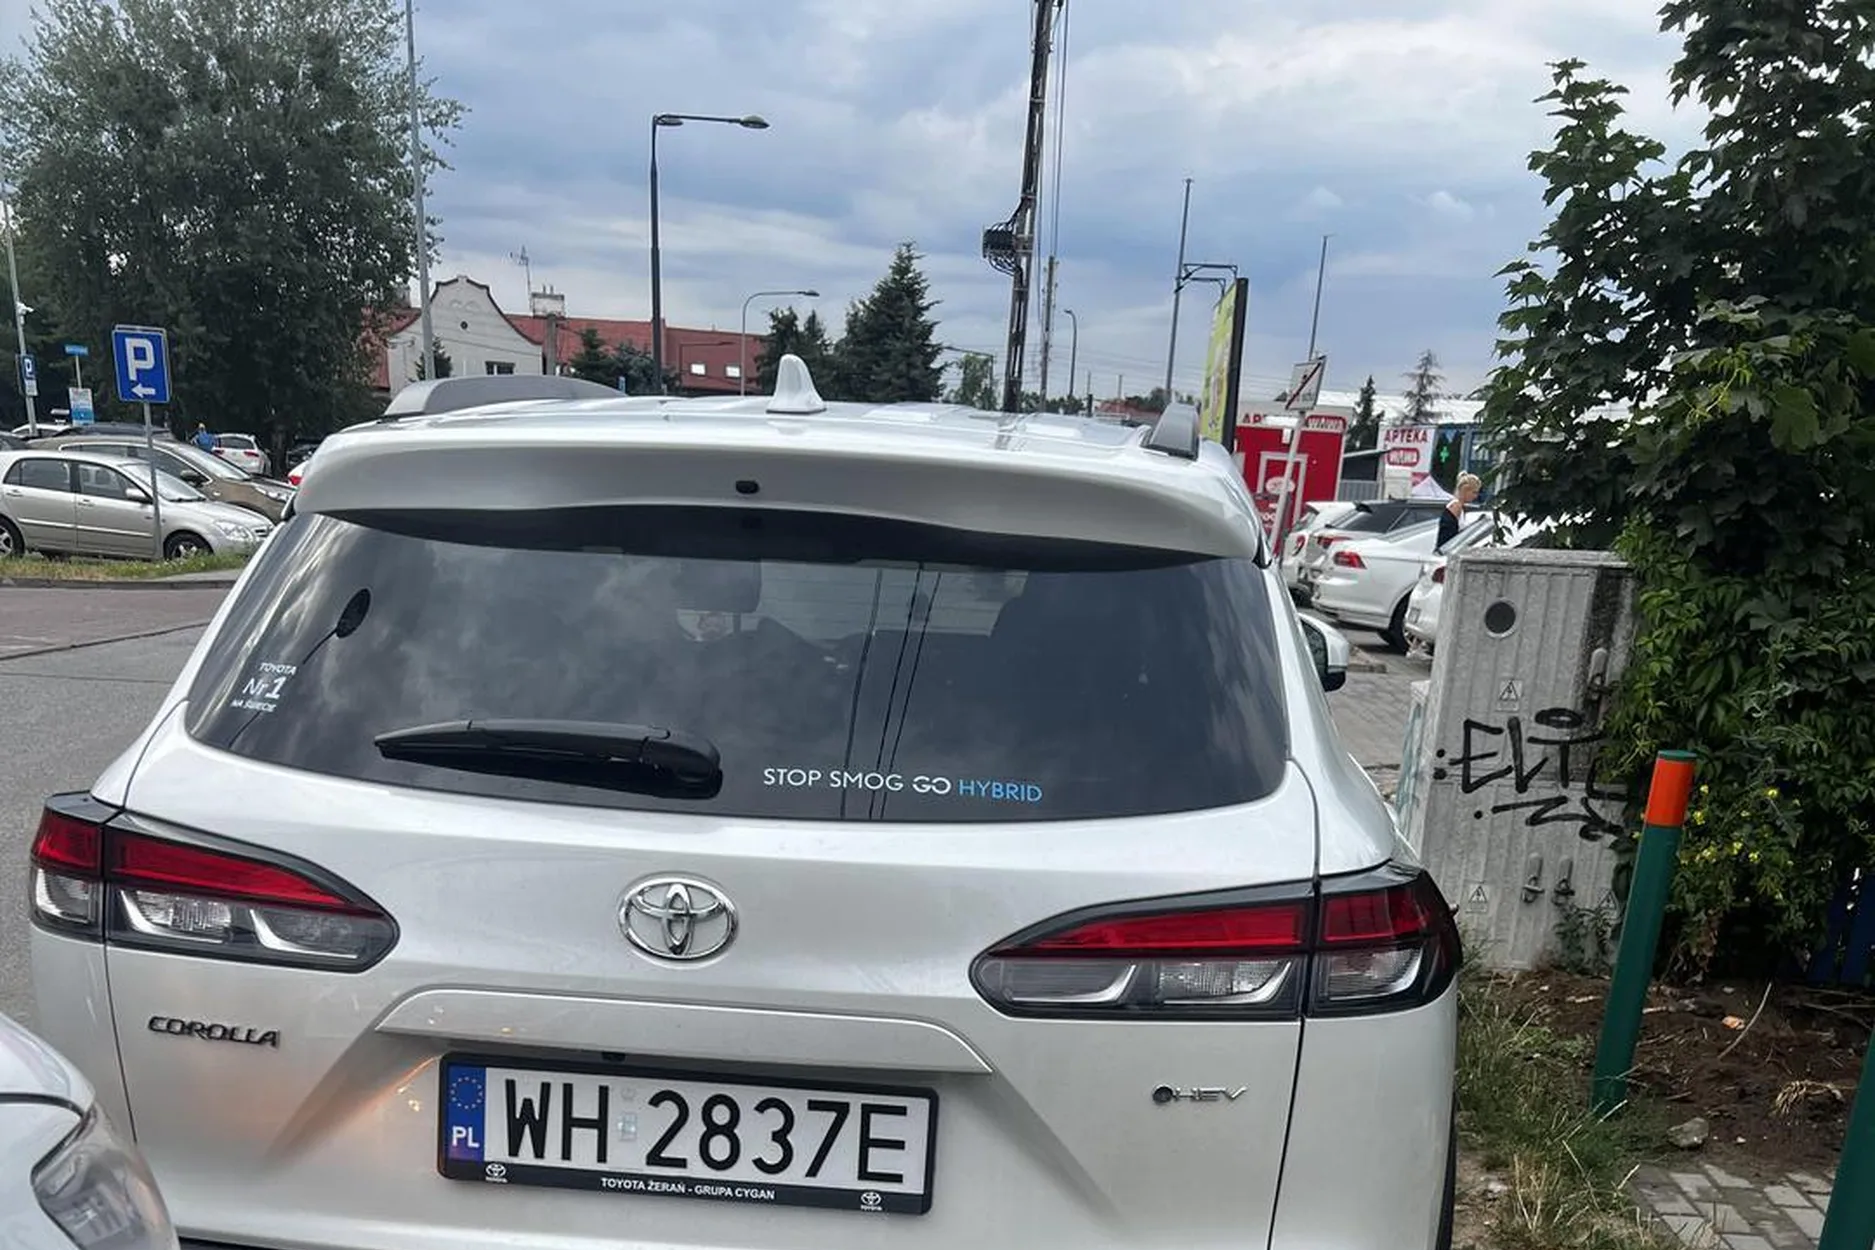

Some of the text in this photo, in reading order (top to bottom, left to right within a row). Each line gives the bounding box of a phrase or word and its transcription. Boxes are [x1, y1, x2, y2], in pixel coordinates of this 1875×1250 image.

[125, 337, 156, 381] P
[1384, 428, 1428, 443] APTEKA
[260, 662, 297, 676] TOYOTA
[242, 676, 287, 700] Nr 1
[763, 768, 1042, 801] STOP SMOG GO HYBRID
[148, 1015, 281, 1049] COROLLA
[452, 1125, 480, 1148] PL
[505, 1078, 908, 1184] WH 2837E
[601, 1177, 645, 1191] TOYOTA
[647, 1180, 686, 1194] ŻERAŃ
[694, 1184, 733, 1198] GRUPA
[734, 1186, 775, 1200] CYGAN
